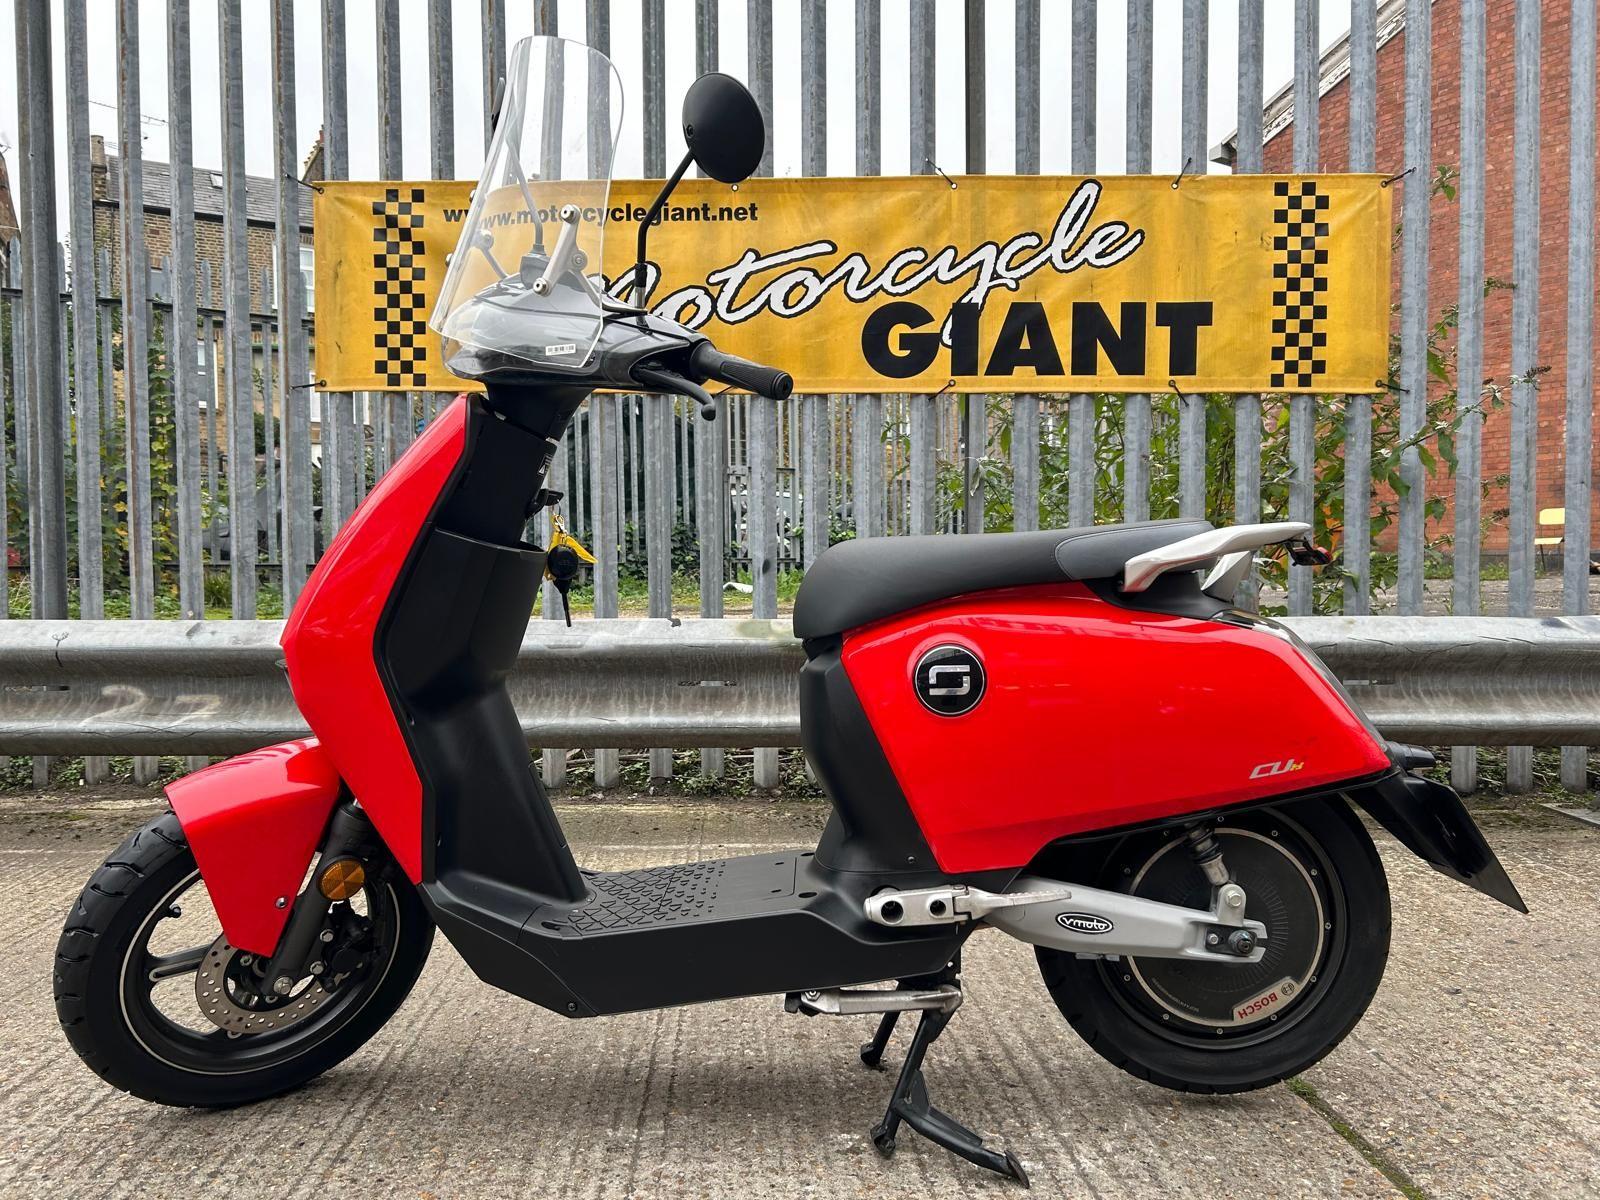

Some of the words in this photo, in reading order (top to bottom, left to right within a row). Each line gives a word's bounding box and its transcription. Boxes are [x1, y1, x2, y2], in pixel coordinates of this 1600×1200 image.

[443, 202, 759, 229] www.motcyclegiant.net
[861, 301, 1213, 378] GIANT
[1238, 992, 1278, 1019] BOSCH
